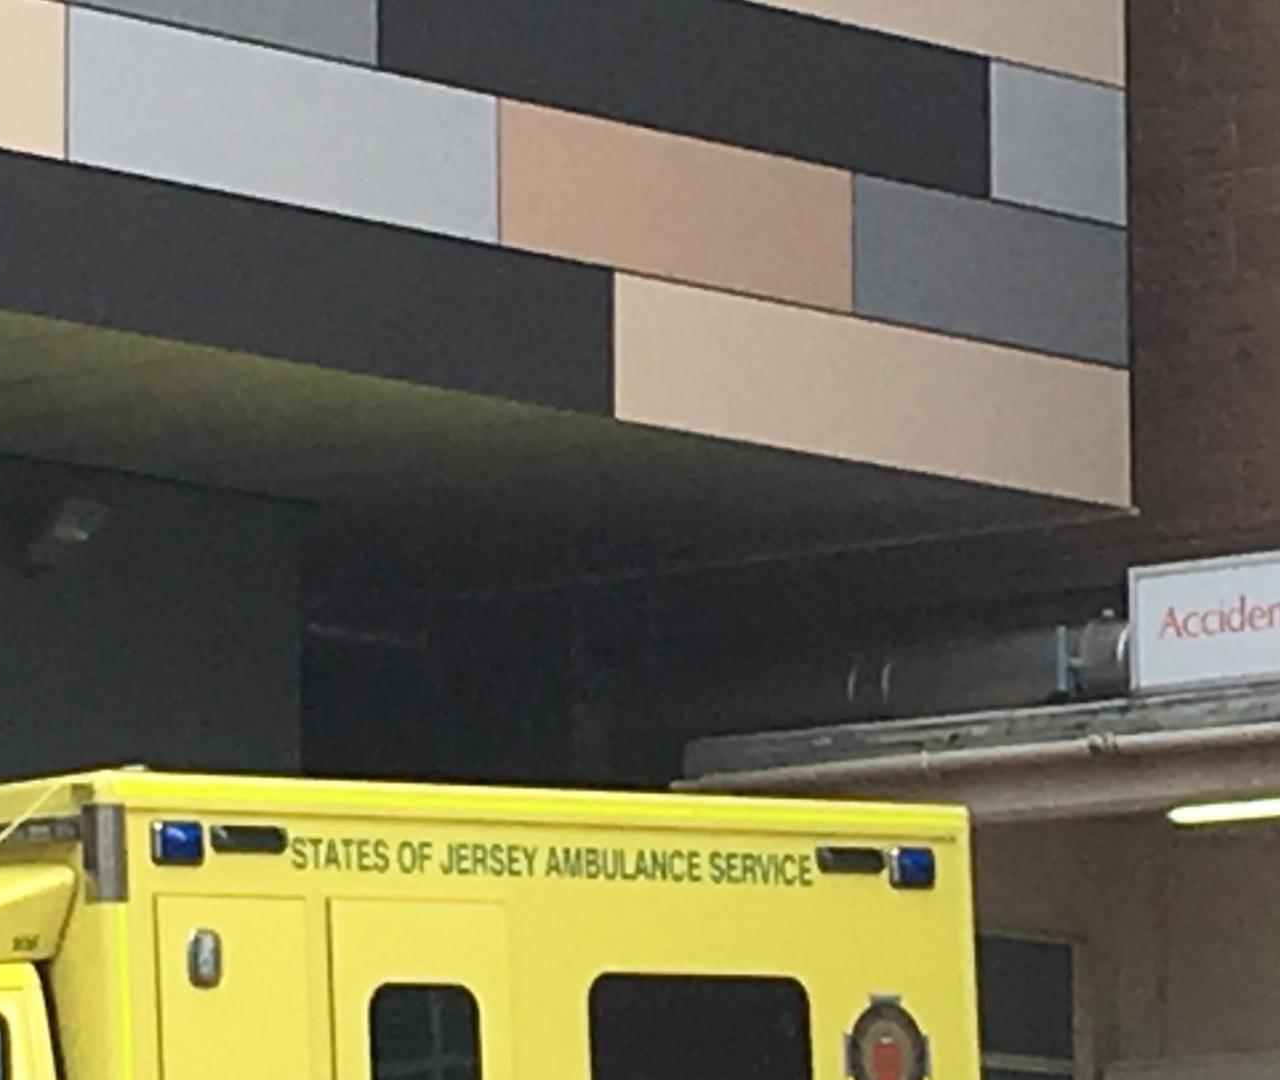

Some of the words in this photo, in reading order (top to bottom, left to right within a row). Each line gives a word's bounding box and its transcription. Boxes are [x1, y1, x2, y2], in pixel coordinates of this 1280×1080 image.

[290, 836, 390, 874] STATES
[396, 840, 433, 874] OF
[439, 843, 537, 877] JERSEY
[545, 846, 701, 882] AMBULANCE
[708, 851, 814, 887] SERVICE
